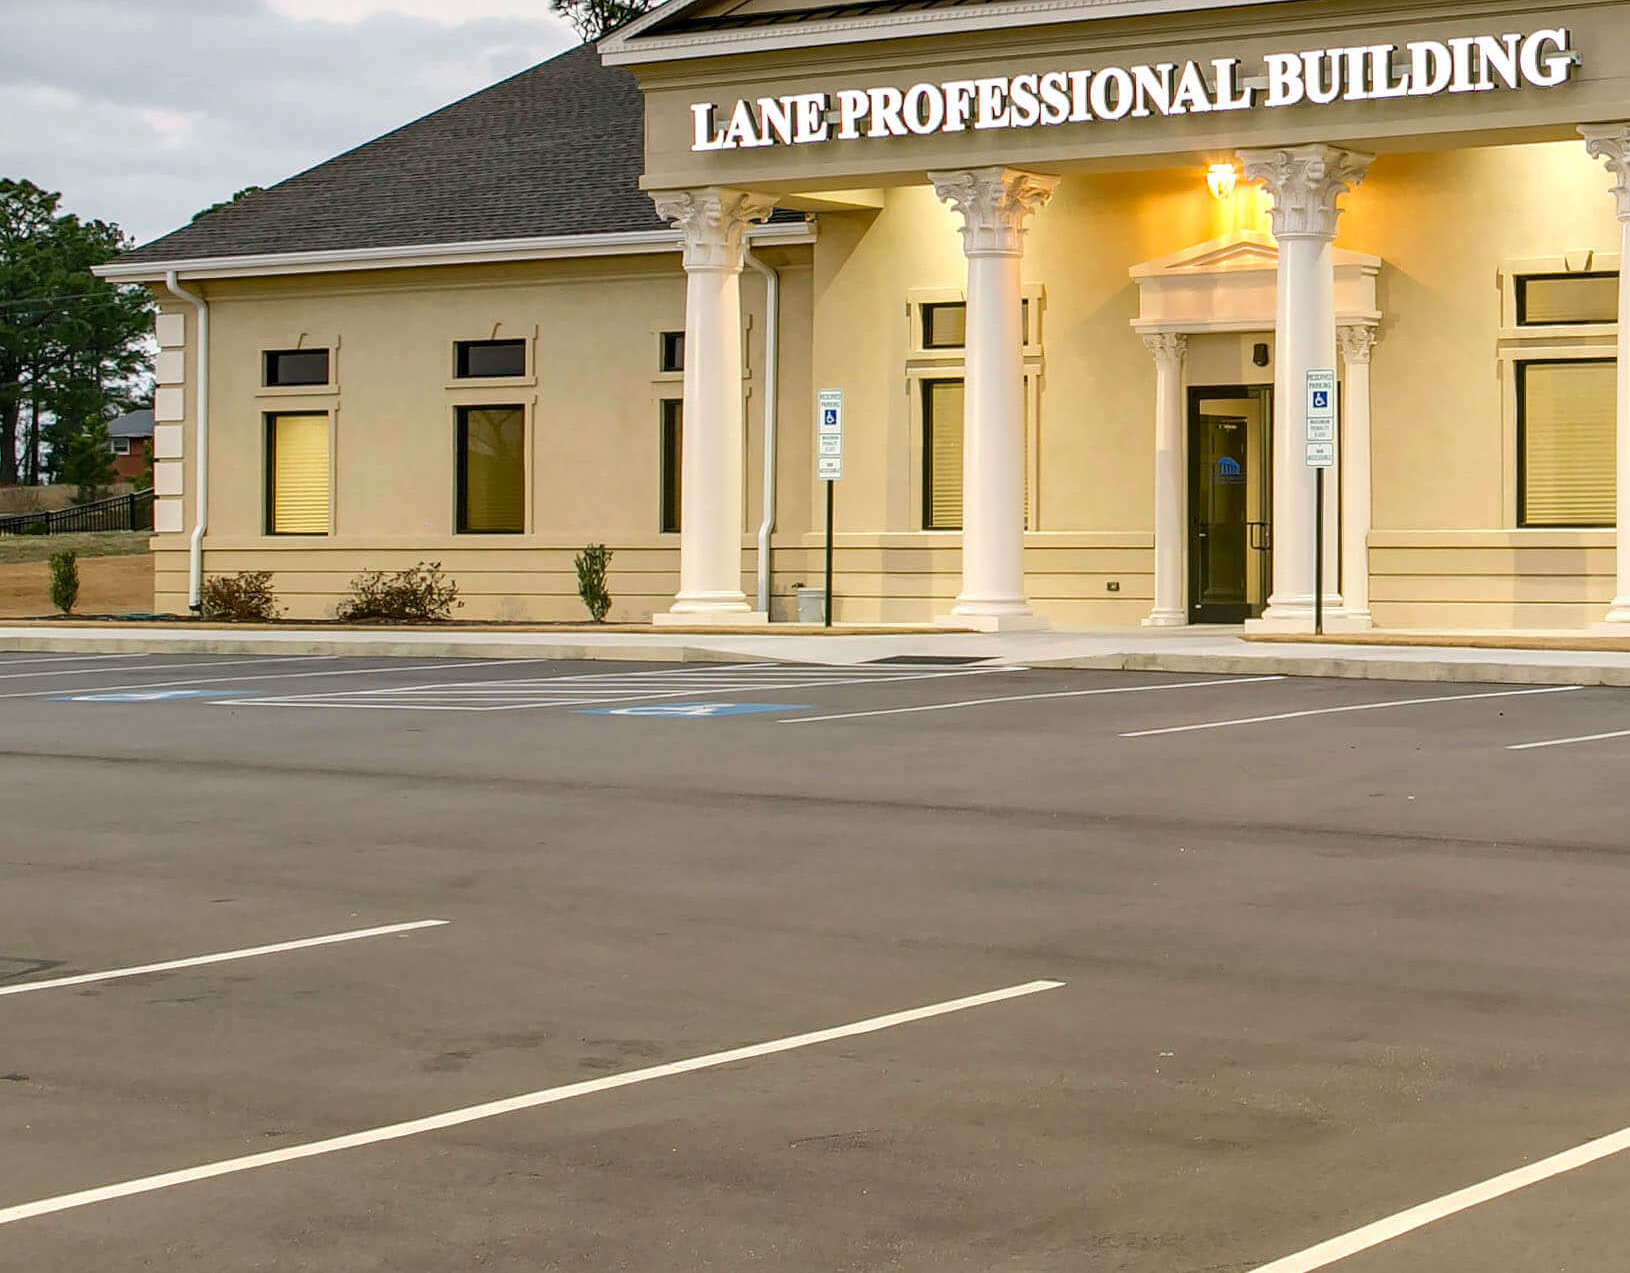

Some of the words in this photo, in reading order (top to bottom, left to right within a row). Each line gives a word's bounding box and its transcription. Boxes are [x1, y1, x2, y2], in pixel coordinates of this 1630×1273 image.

[690, 92, 829, 152] LANE
[836, 57, 1253, 140] PROFESSIONAL
[1263, 26, 1573, 108] BUILDING
